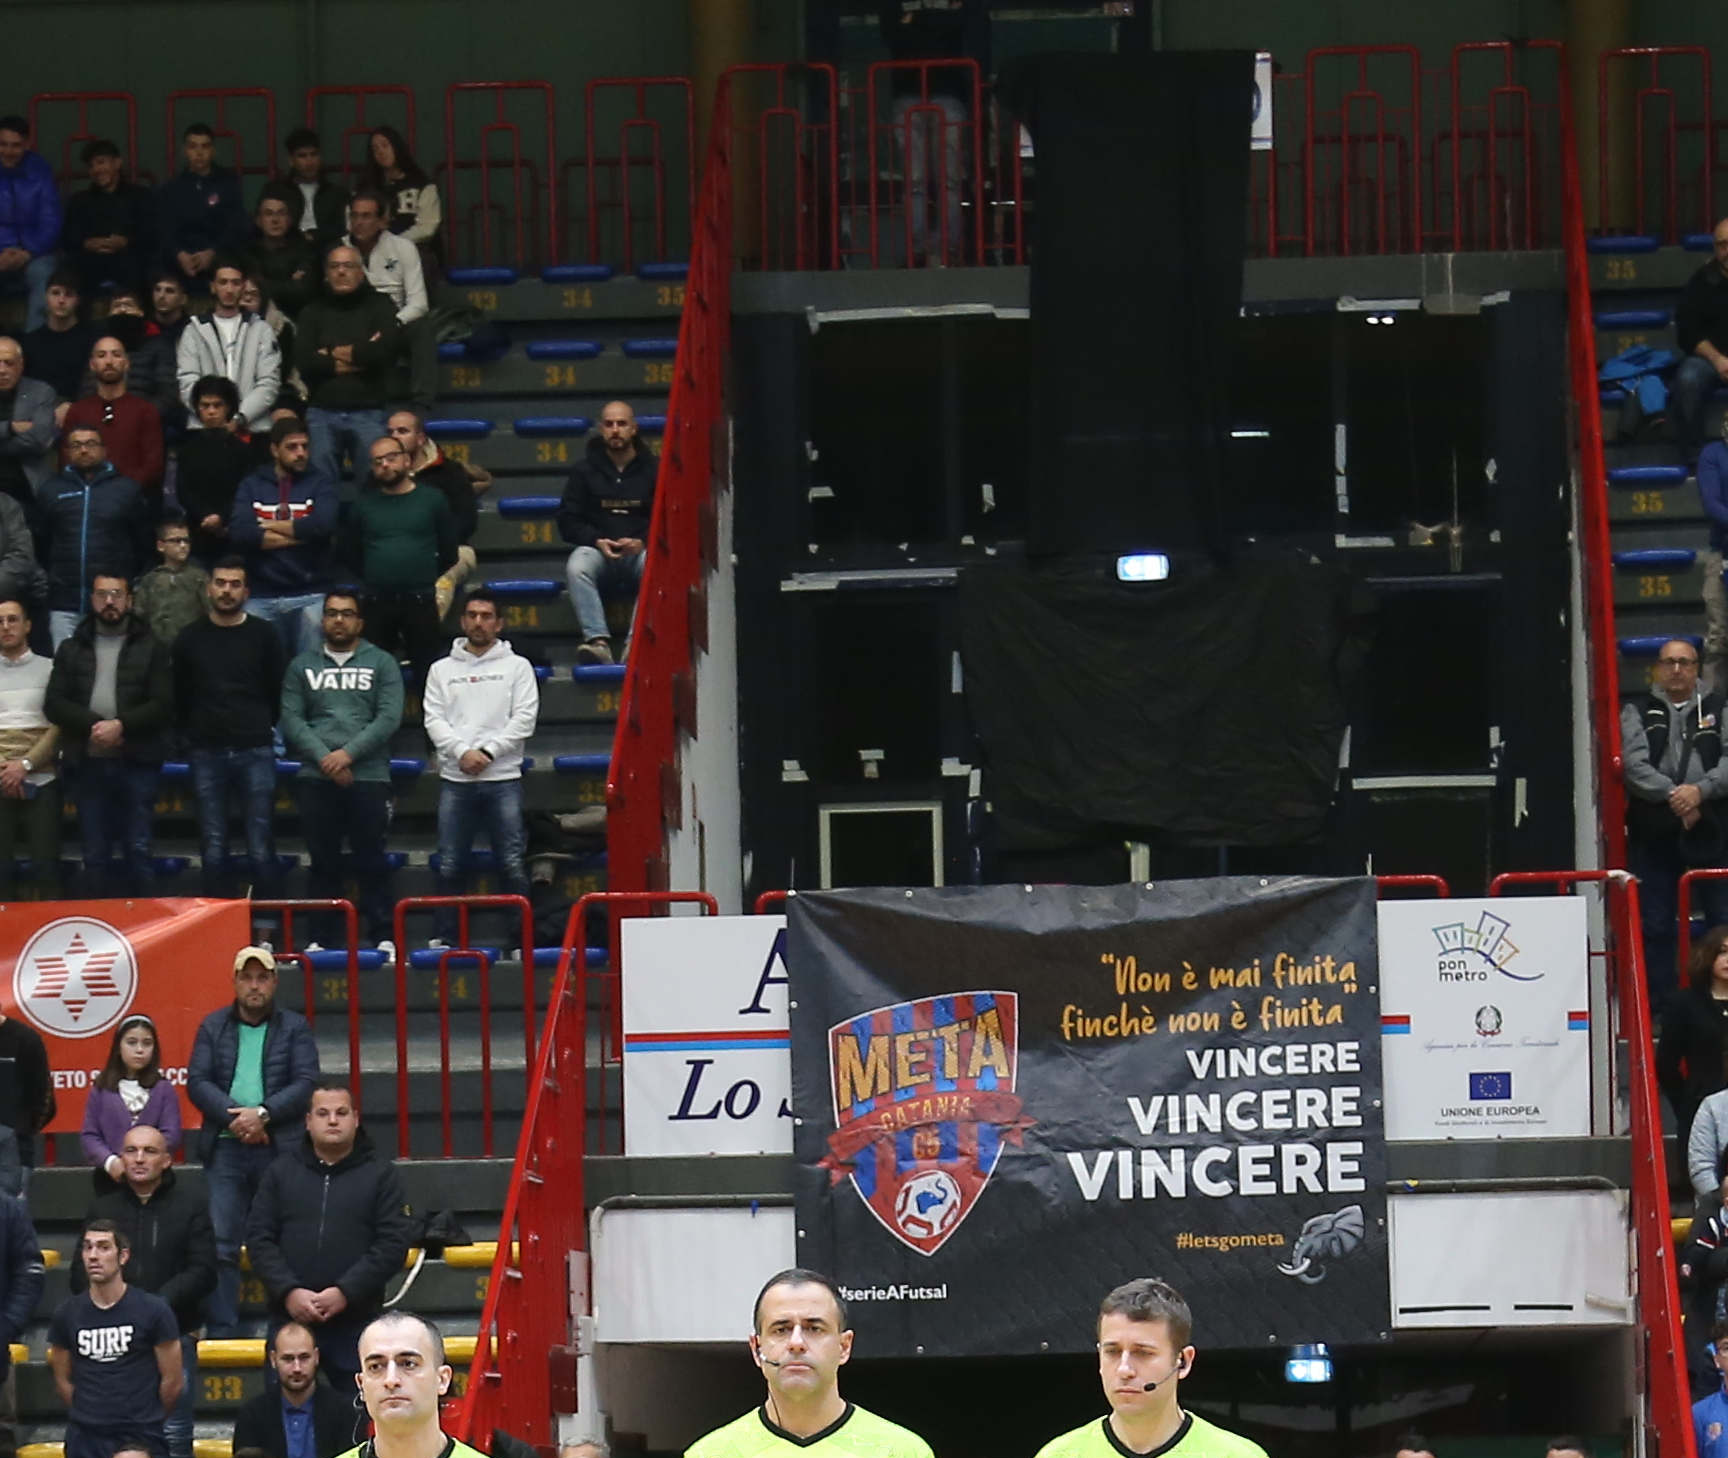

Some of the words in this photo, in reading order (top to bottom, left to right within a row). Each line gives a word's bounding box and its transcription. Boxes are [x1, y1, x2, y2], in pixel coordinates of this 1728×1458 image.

[305, 668, 375, 692] VANS
[1182, 962, 1198, 990] è
[1209, 959, 1261, 990] mai
[1272, 953, 1357, 988] finita
[1438, 959, 1467, 971] pon
[1439, 969, 1488, 982] metro
[1061, 1002, 1157, 1040] finchè
[1169, 1011, 1219, 1034] non
[1231, 1000, 1248, 1031] è
[837, 1007, 1011, 1112] META
[1186, 1042, 1361, 1079] VINCERE
[668, 1059, 760, 1120] Lo
[881, 1096, 972, 1131] CATANIA
[1127, 1086, 1362, 1135] VINCERE
[1441, 1107, 1484, 1118] UNIONE
[1486, 1105, 1540, 1117] EUROPEA
[1066, 1141, 1366, 1201] VINCERE
[1176, 1233, 1285, 1251] #letsgometa
[77, 1326, 133, 1356] SURF
